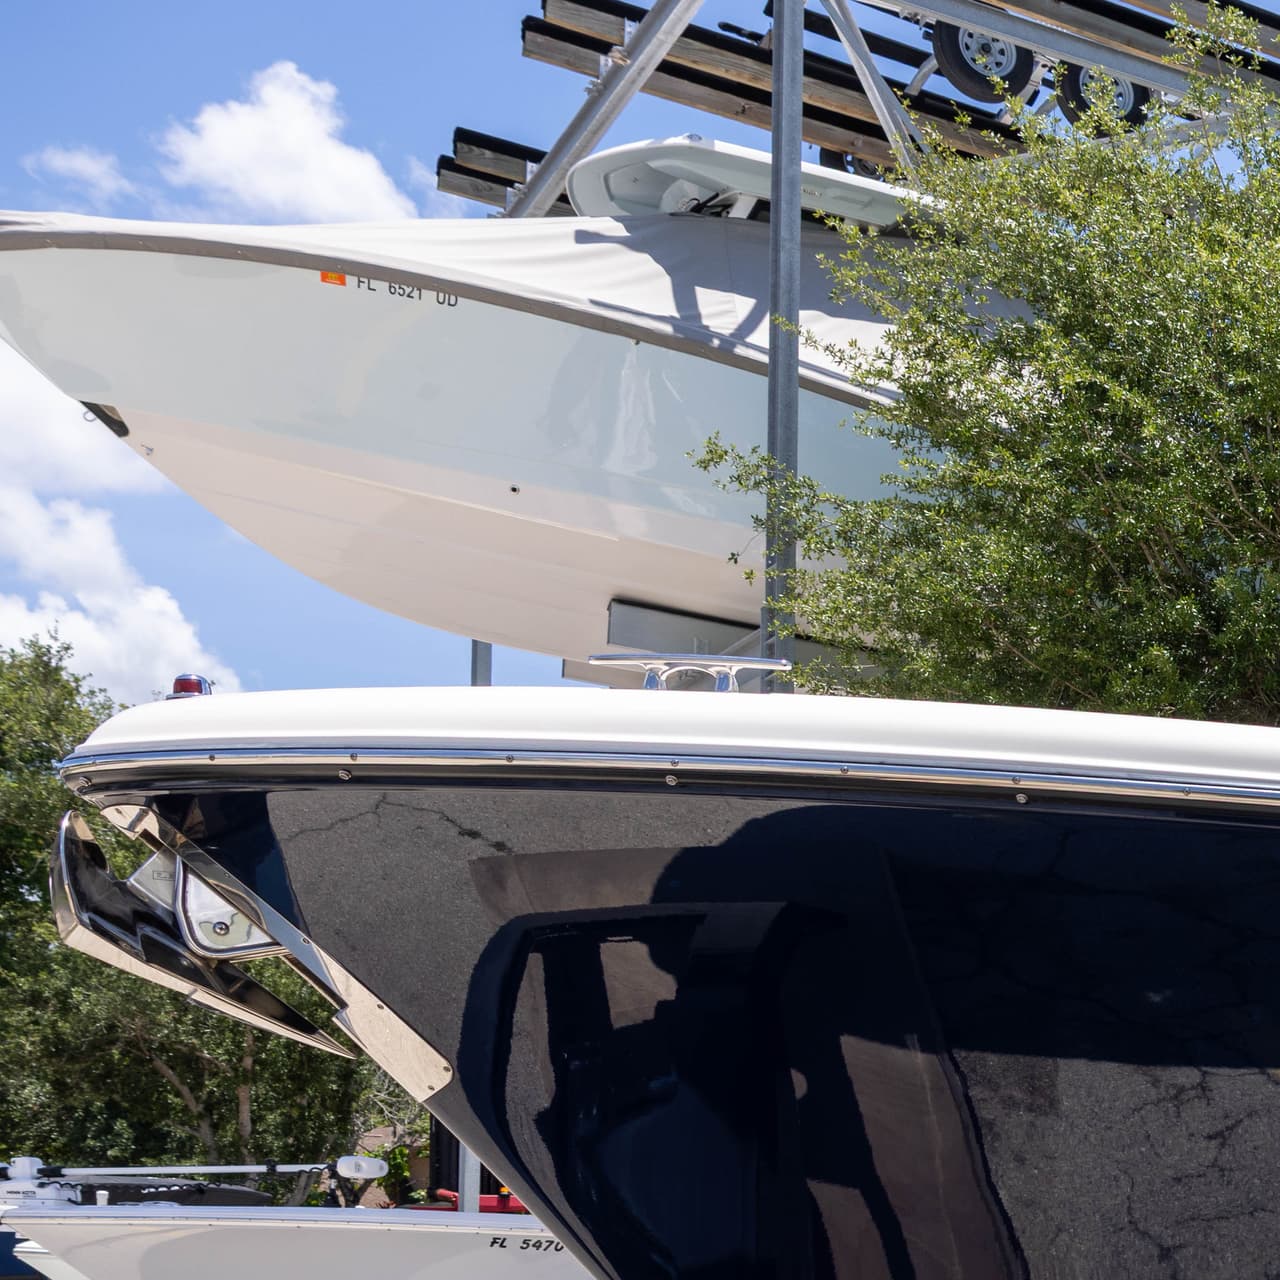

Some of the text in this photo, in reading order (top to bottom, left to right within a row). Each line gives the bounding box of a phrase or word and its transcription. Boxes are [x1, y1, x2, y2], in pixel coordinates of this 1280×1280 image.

[357, 276, 376, 292] FL
[388, 283, 422, 301] 6521
[489, 1237, 507, 1249] FL
